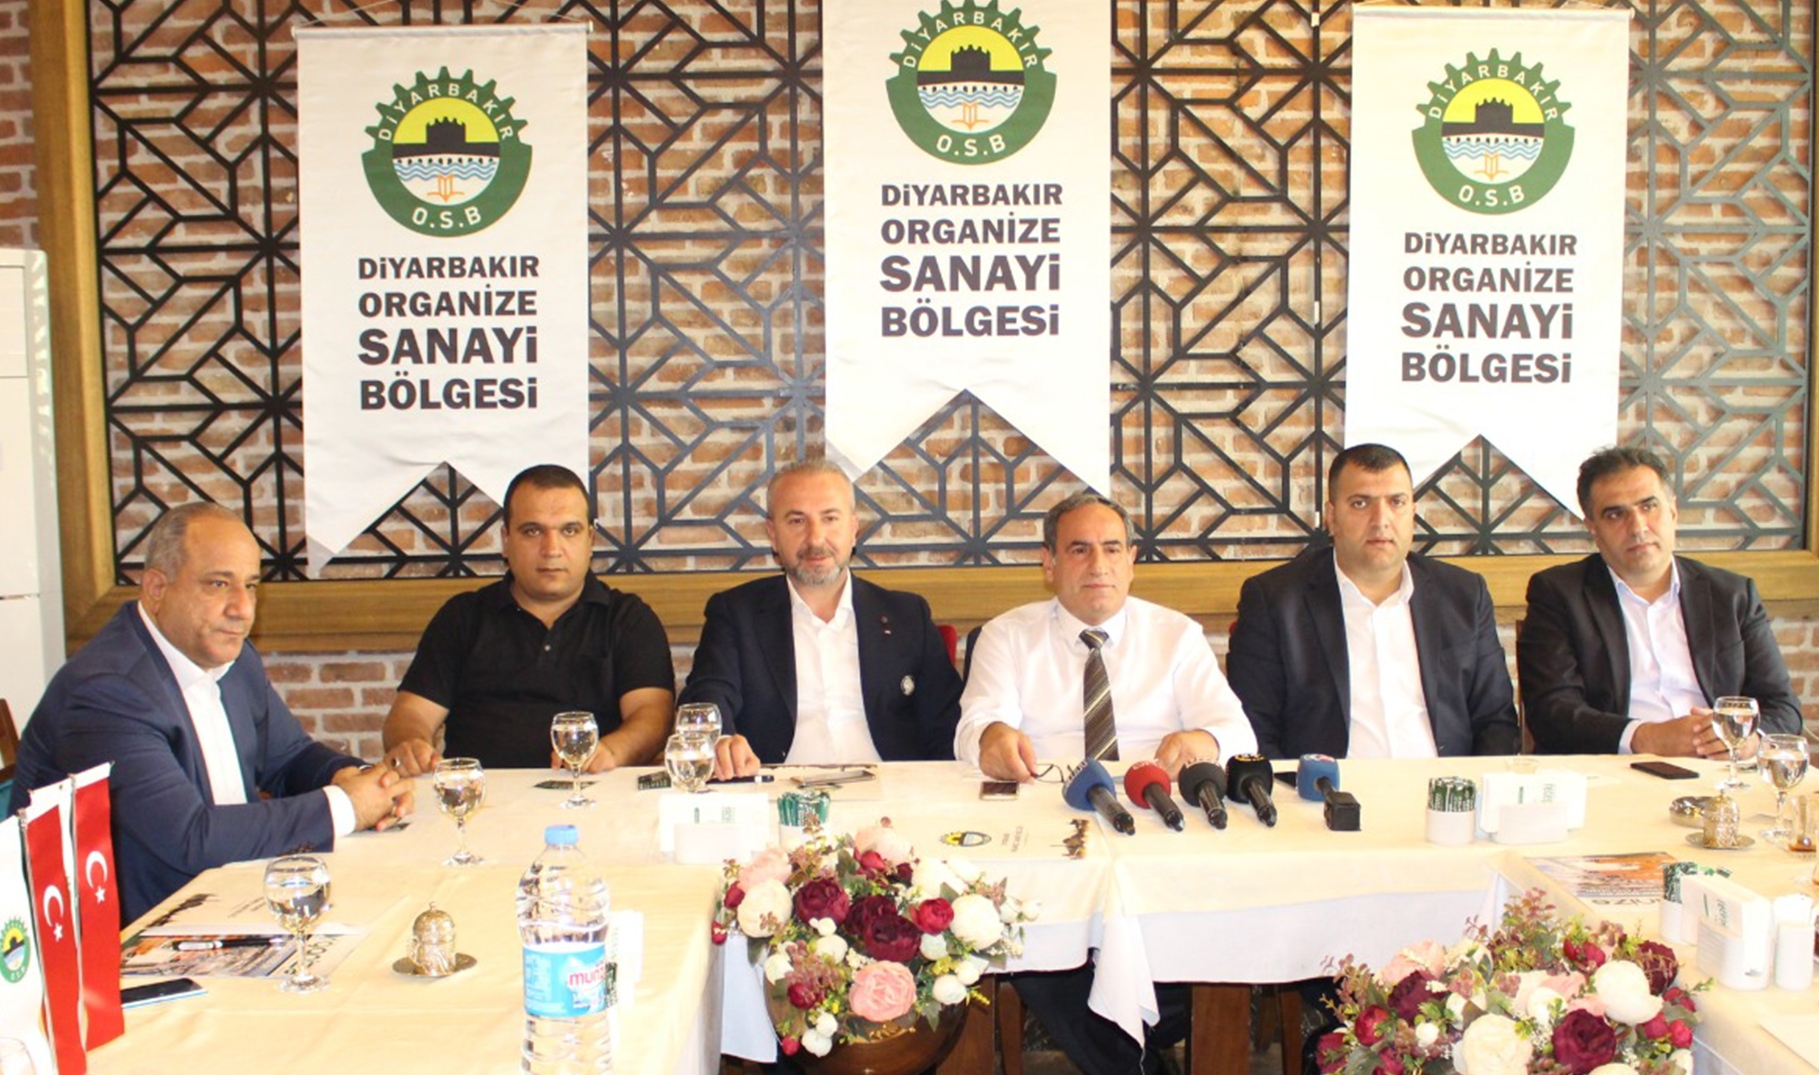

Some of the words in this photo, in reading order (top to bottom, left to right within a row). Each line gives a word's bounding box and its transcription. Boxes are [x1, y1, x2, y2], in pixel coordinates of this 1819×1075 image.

[936, 134, 1005, 156] O.S.B
[1458, 184, 1525, 206] O.S.B
[412, 206, 481, 228] O.S.B
[881, 211, 1060, 245] ORGANİZE
[1403, 261, 1574, 292] ORGANİZE
[358, 283, 537, 318] ORGANİZE
